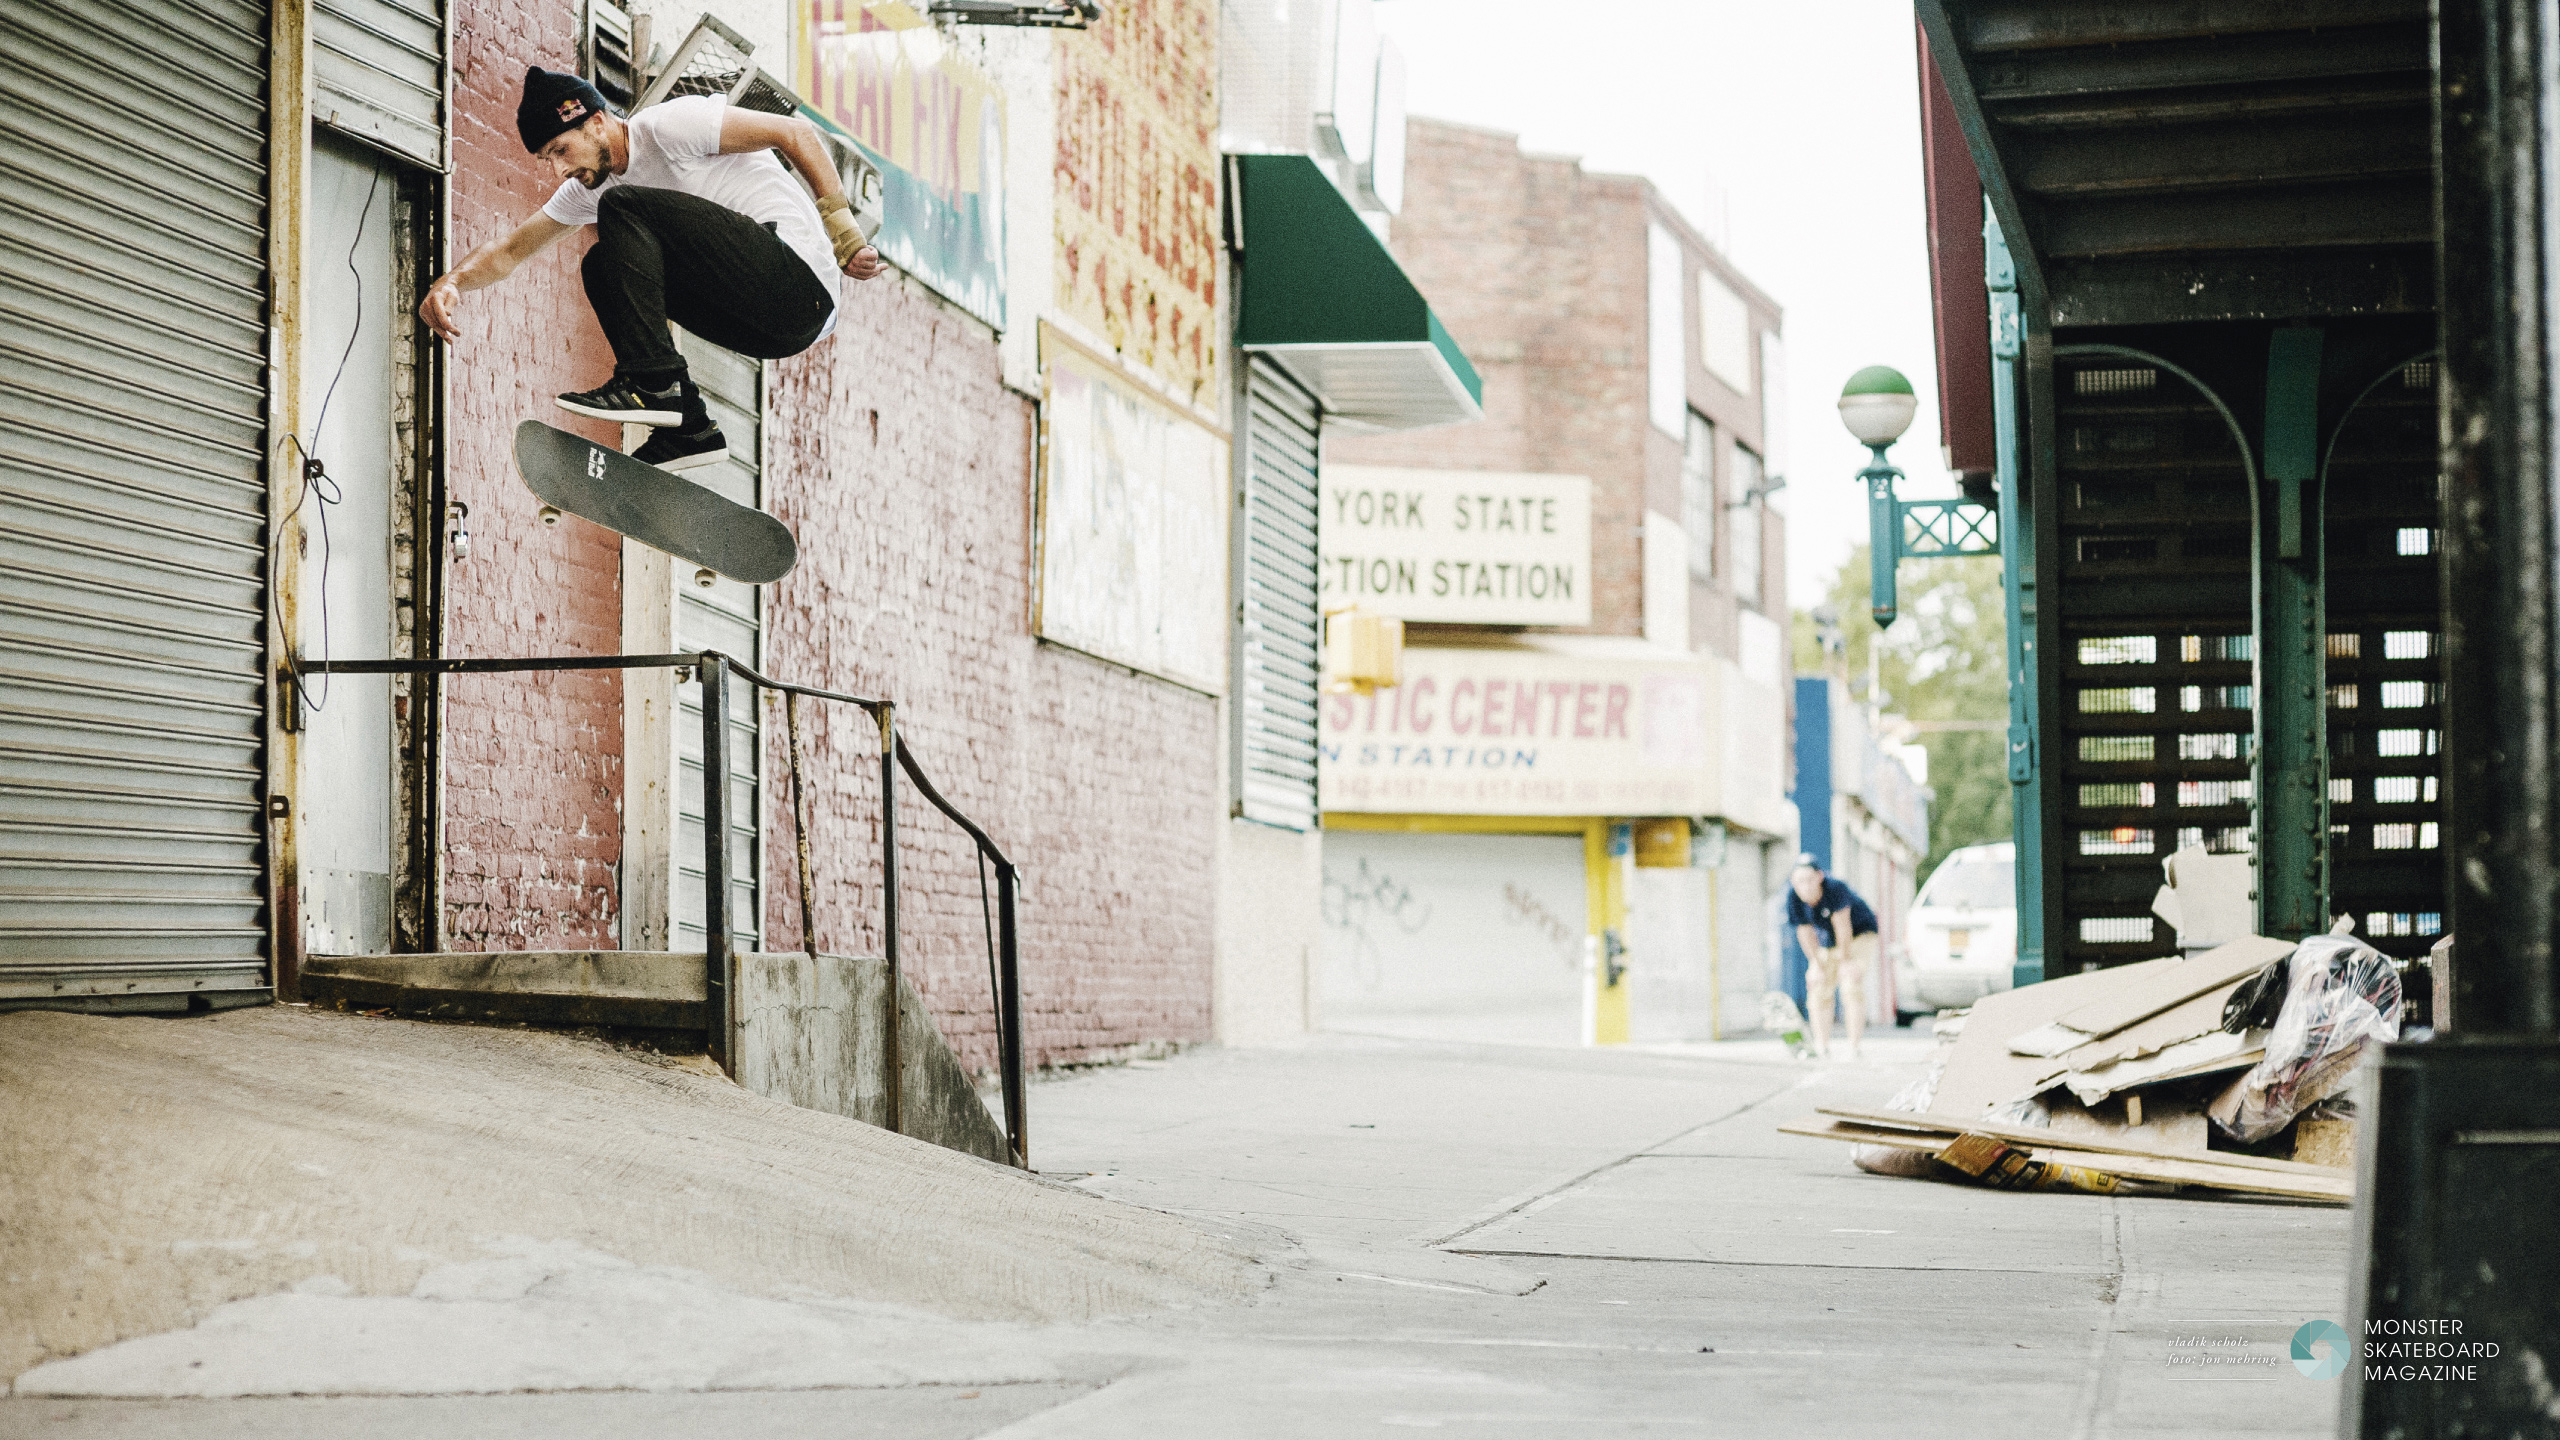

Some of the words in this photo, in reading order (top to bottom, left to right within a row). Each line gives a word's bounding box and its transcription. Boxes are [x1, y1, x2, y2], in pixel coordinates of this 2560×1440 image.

[1334, 489, 1425, 529] YORK
[1455, 495, 1556, 534] STATE
[1433, 560, 1573, 599] STATION
[1450, 679, 1630, 739] CENTER
[1358, 745, 1539, 769] STATION
